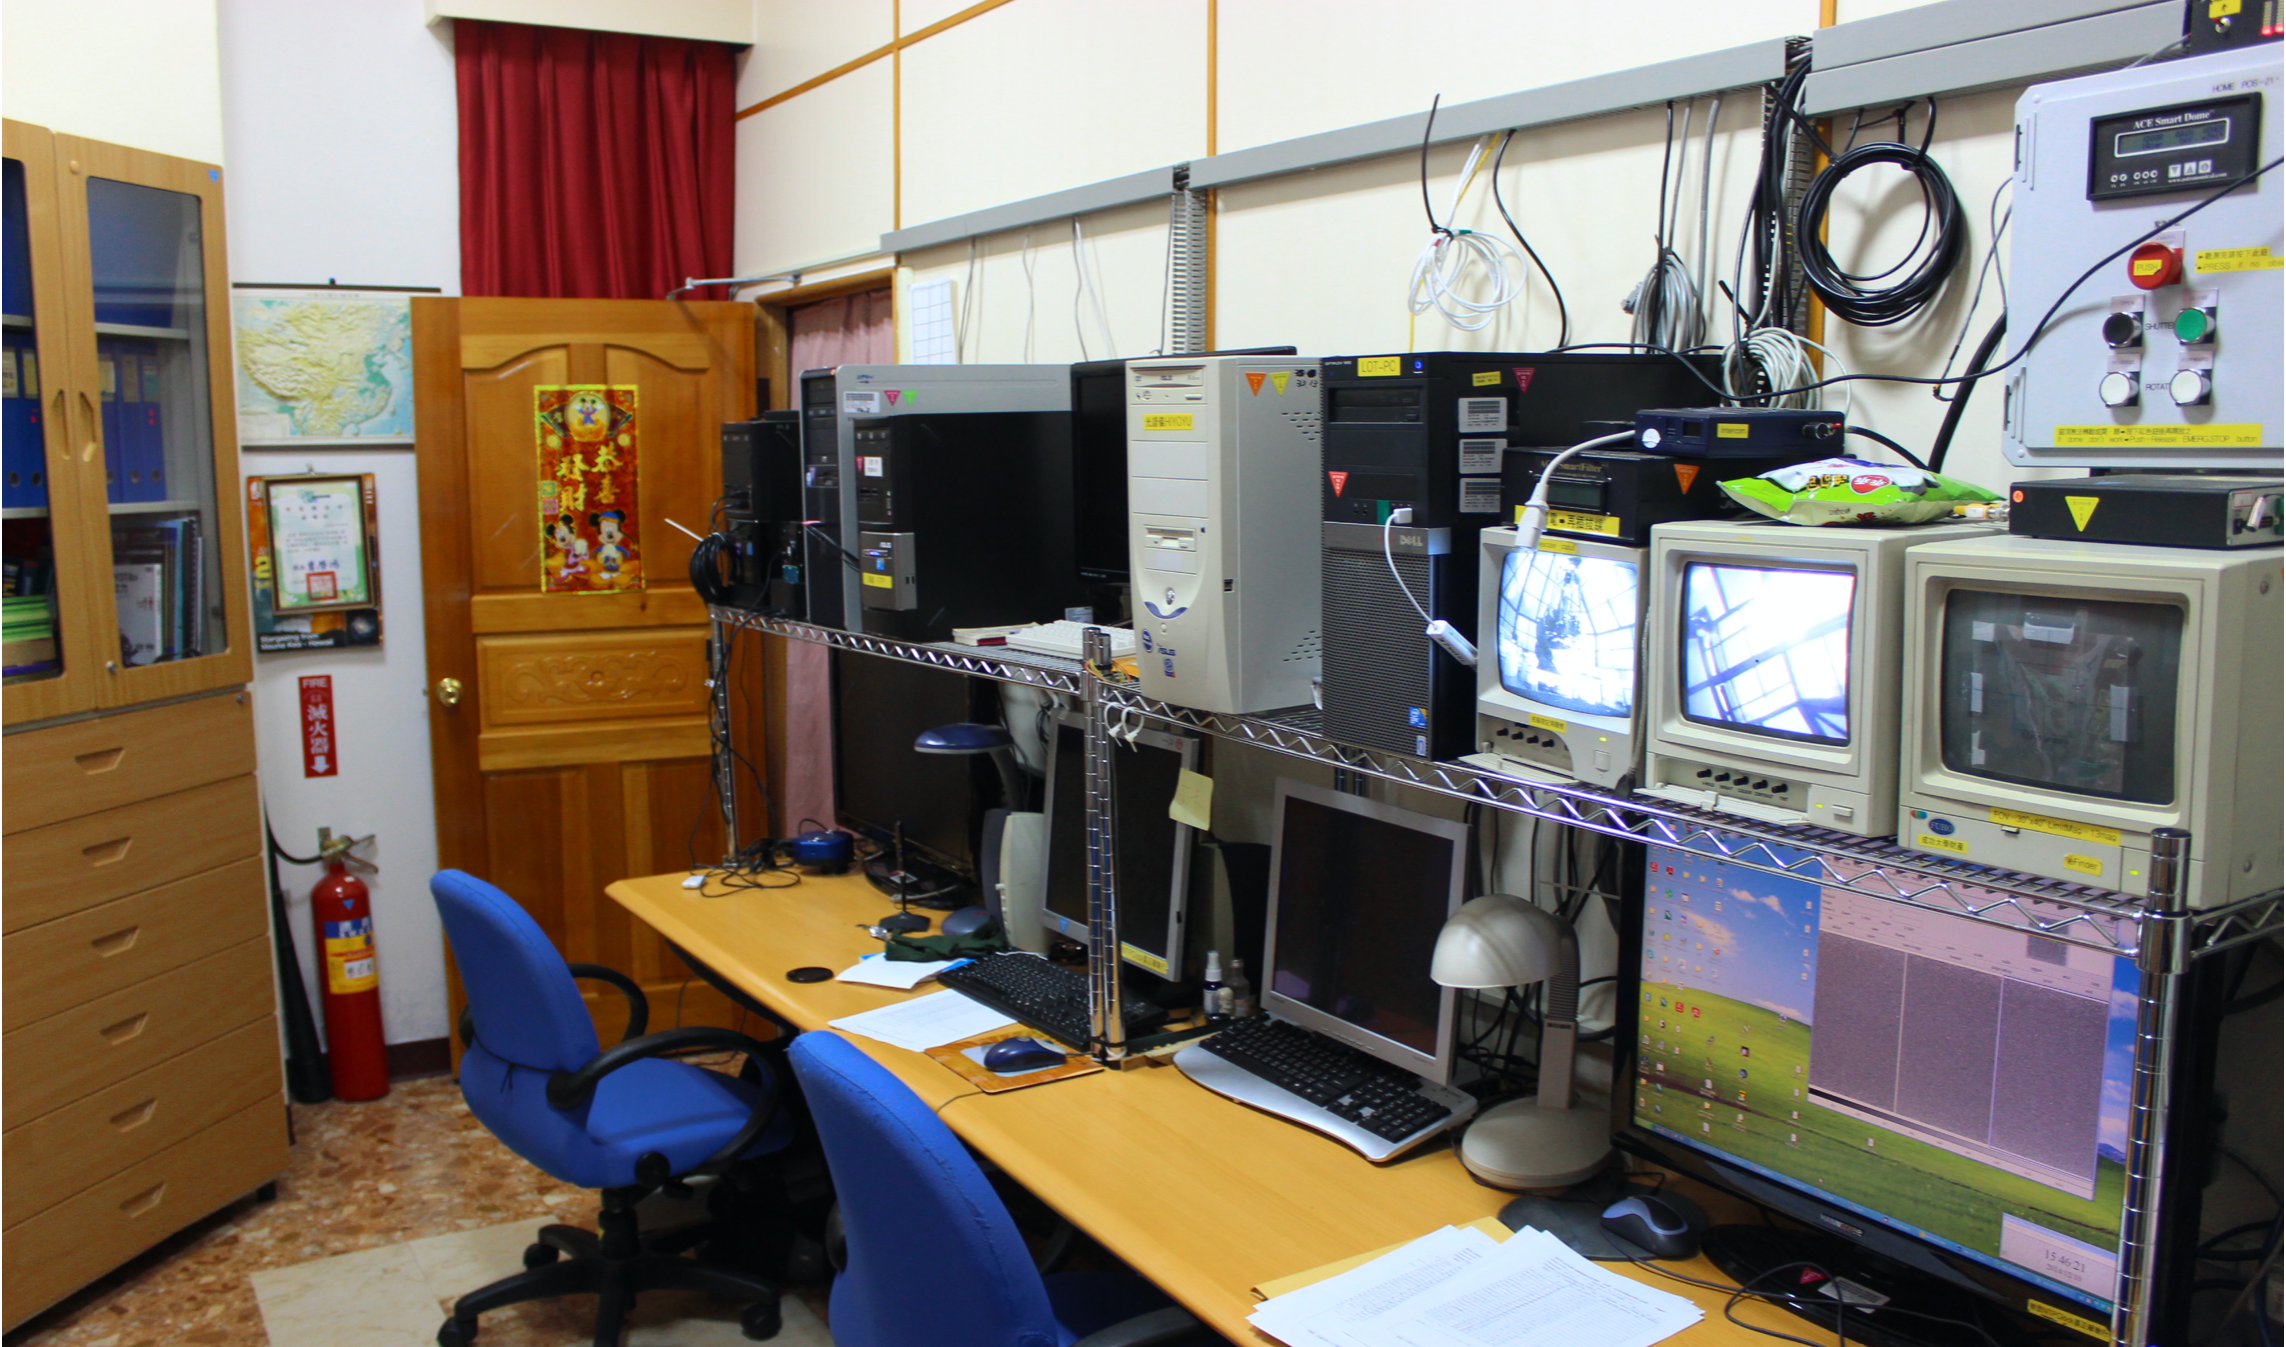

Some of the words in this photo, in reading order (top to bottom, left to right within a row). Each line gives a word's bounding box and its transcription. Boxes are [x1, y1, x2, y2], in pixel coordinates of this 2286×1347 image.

[2212, 82, 2235, 92] HOME
[2133, 118, 2154, 130] ACE
[2155, 114, 2183, 127] Smart
[2137, 263, 2159, 271] PUSH
[2203, 262, 2231, 271] PRESS
[2145, 322, 2175, 331] SHUTTE
[1361, 360, 1397, 373] LOT-PC
[2145, 383, 2170, 391] ROTAT
[1721, 427, 1747, 435] Intercom
[2236, 435, 2258, 443] button
[1400, 534, 1423, 547] DELL
[302, 677, 328, 689] FIRE
[306, 703, 330, 755] 滅火器
[1993, 810, 2011, 820] FOV
[2068, 858, 2098, 871] eFinder
[2044, 1249, 2086, 1273] 15:46:21
